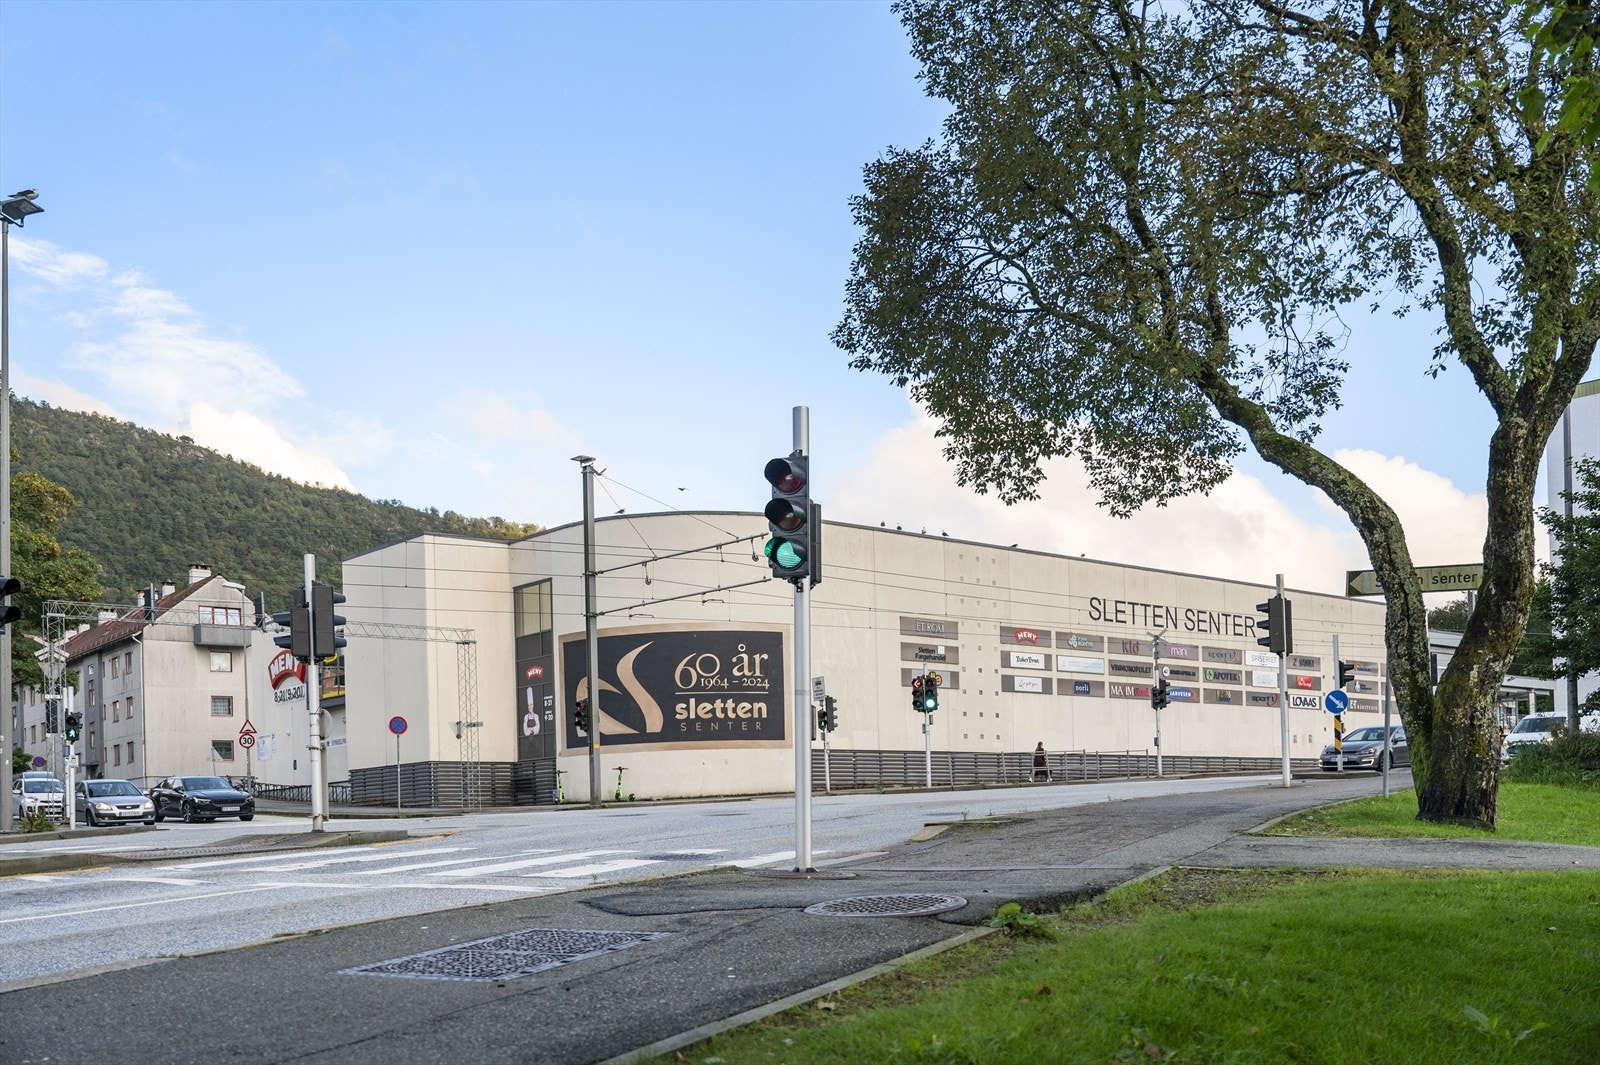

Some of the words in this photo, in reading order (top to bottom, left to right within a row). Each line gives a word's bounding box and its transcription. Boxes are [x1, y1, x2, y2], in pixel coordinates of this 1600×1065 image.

[1431, 572, 1478, 585] senter
[1088, 596, 1179, 630] SLETTEN
[1184, 608, 1257, 638] SENTER
[1017, 631, 1037, 641] MENY
[269, 653, 301, 679] MENY
[527, 668, 543, 677] MENY
[674, 652, 721, 689] 60
[731, 643, 769, 677] år
[700, 674, 729, 689] 1964
[742, 677, 770, 689] 2024
[1075, 683, 1089, 692] norli
[675, 698, 768, 719] sletten
[680, 722, 762, 732] SENTER
[242, 737, 252, 745] 30
